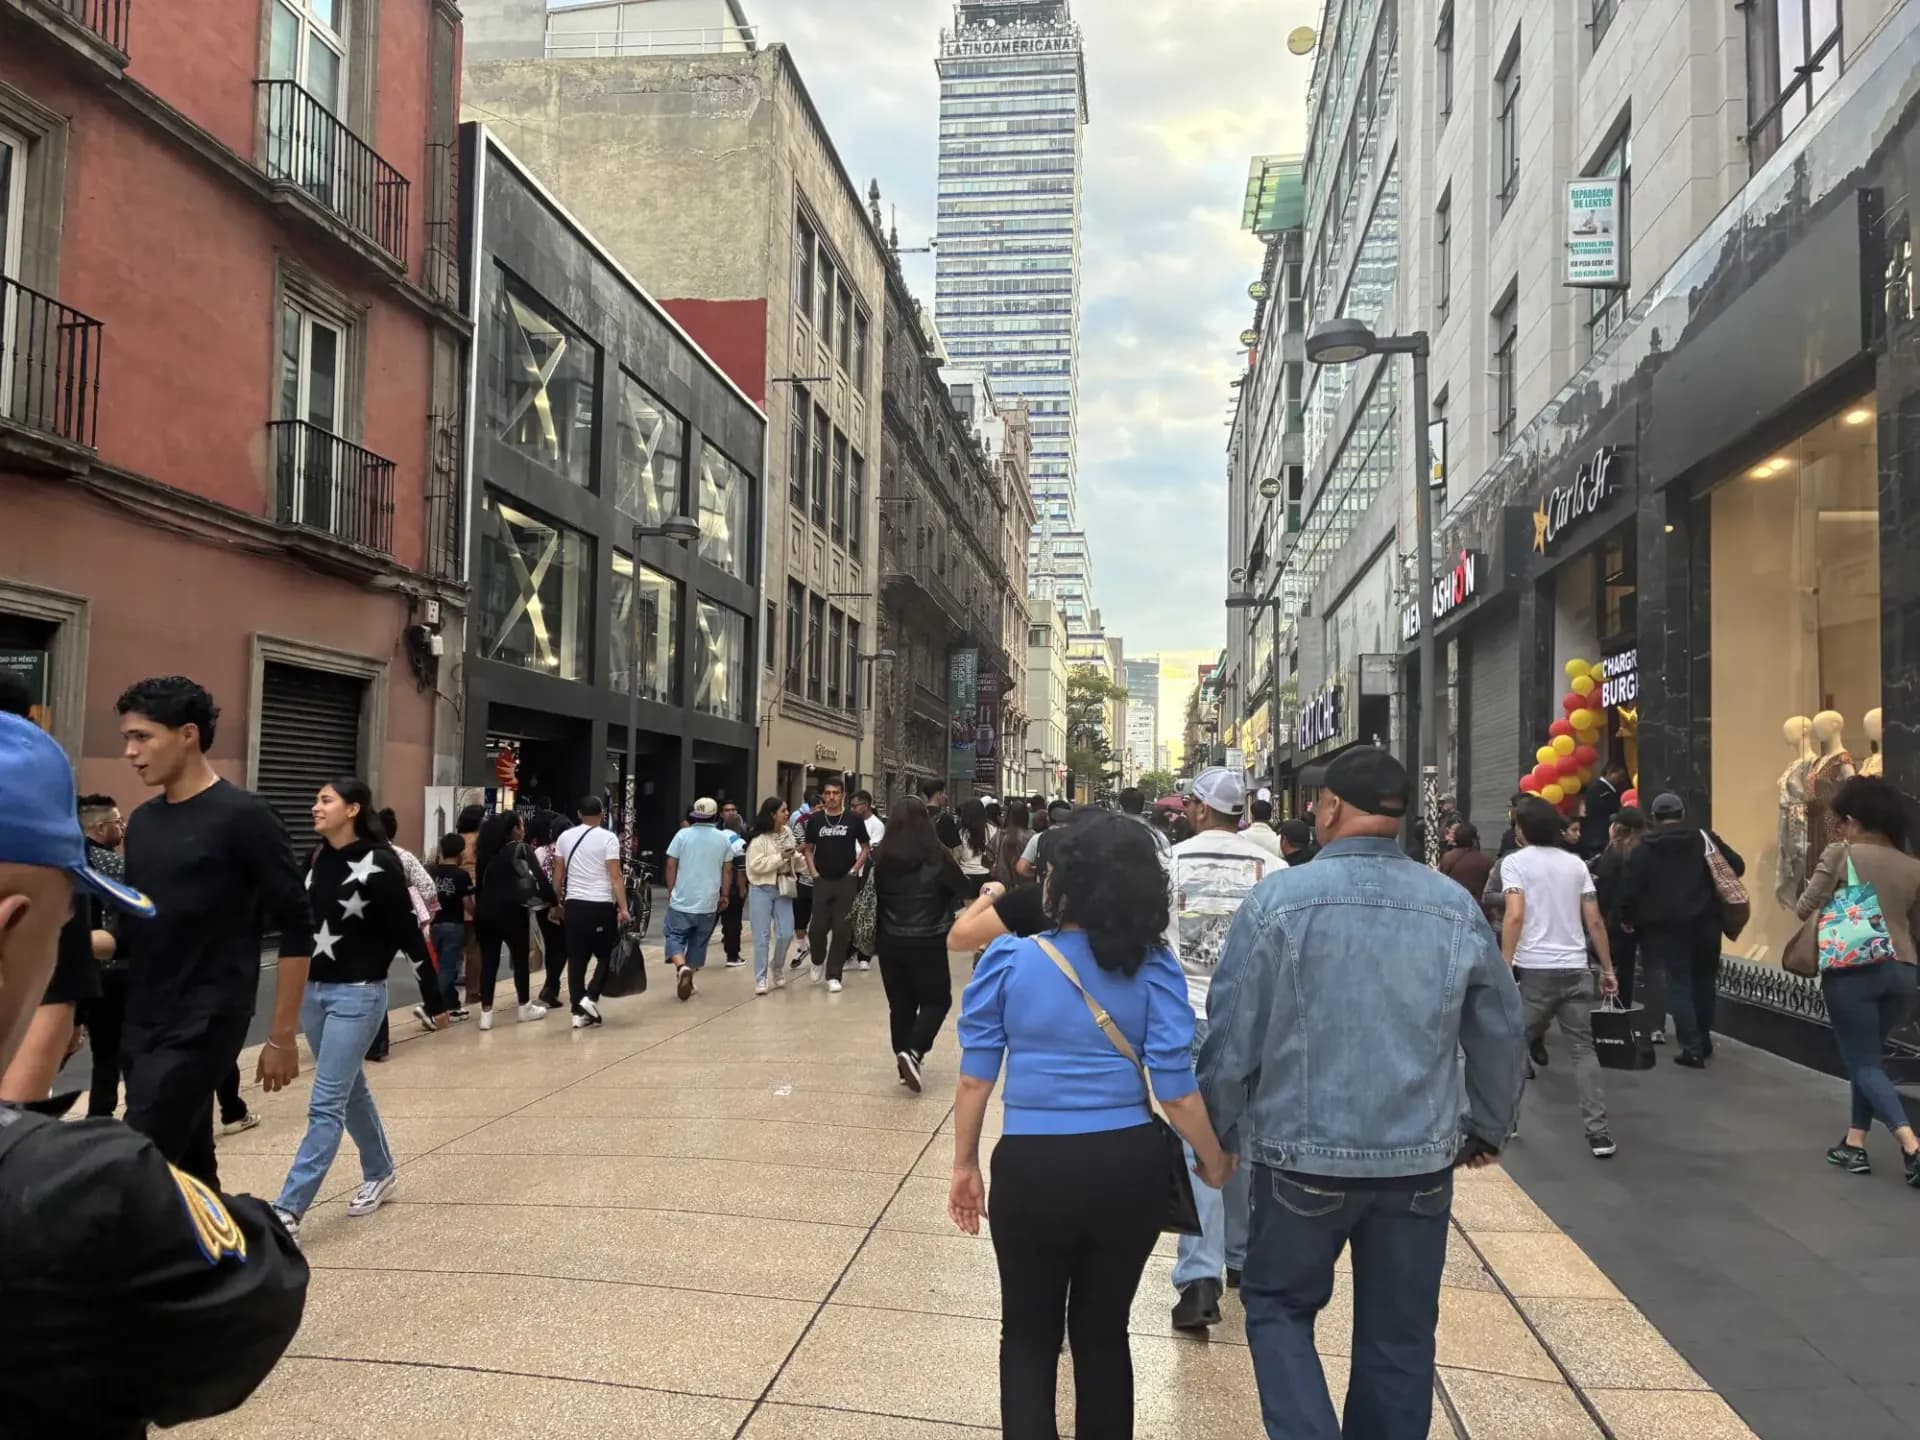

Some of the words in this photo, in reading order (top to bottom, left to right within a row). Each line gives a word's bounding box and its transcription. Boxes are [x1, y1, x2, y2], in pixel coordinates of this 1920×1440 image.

[946, 39, 1070, 57] LATINOAMERICANA
[1571, 186, 1614, 200] REPARACIÓN
[1574, 200, 1583, 208] DE
[1585, 198, 1612, 208] LENTES
[1547, 463, 1587, 542] Carl's
[1432, 550, 1475, 619] ASHION
